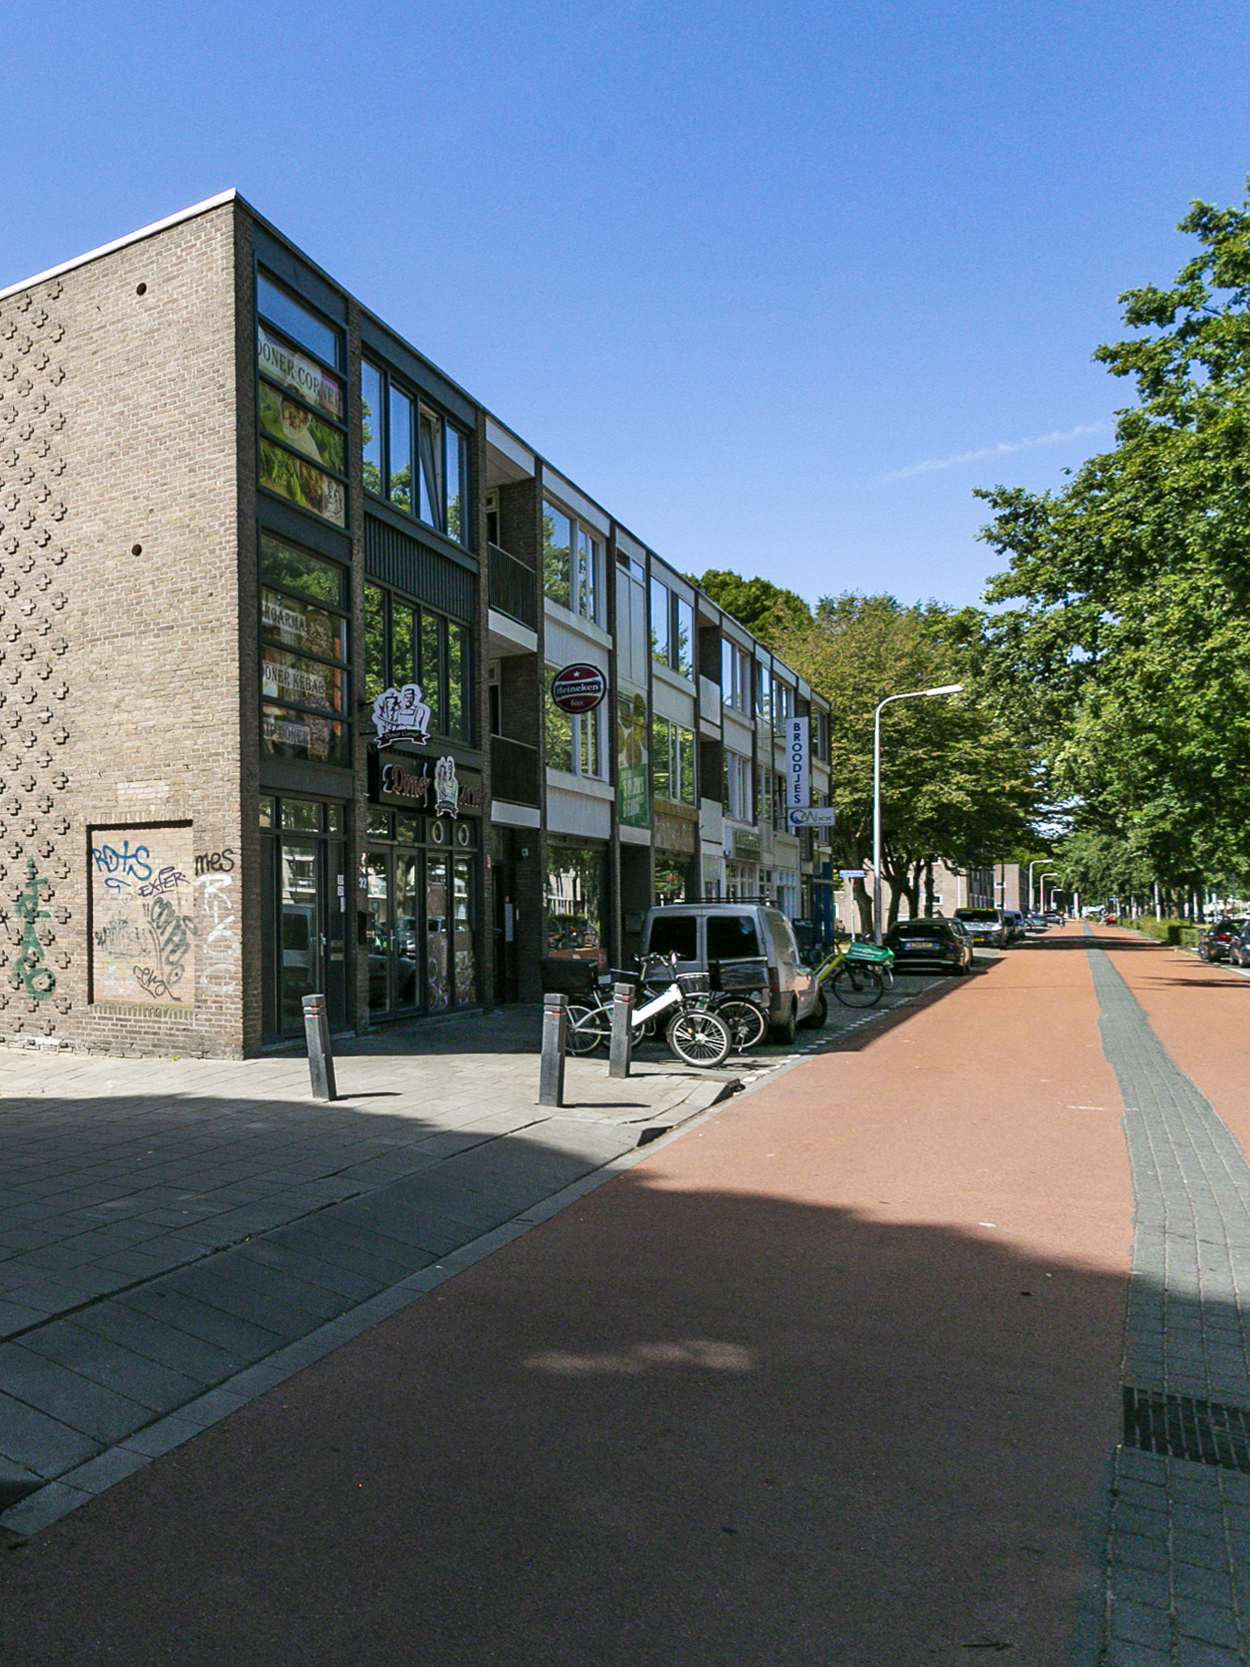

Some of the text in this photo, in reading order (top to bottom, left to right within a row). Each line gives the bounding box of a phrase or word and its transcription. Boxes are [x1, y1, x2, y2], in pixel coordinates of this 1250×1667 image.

[262, 603, 307, 632] HOARMA
[263, 665, 290, 687] ONER
[556, 683, 599, 695] Heineken
[791, 722, 803, 804] BROODJES
